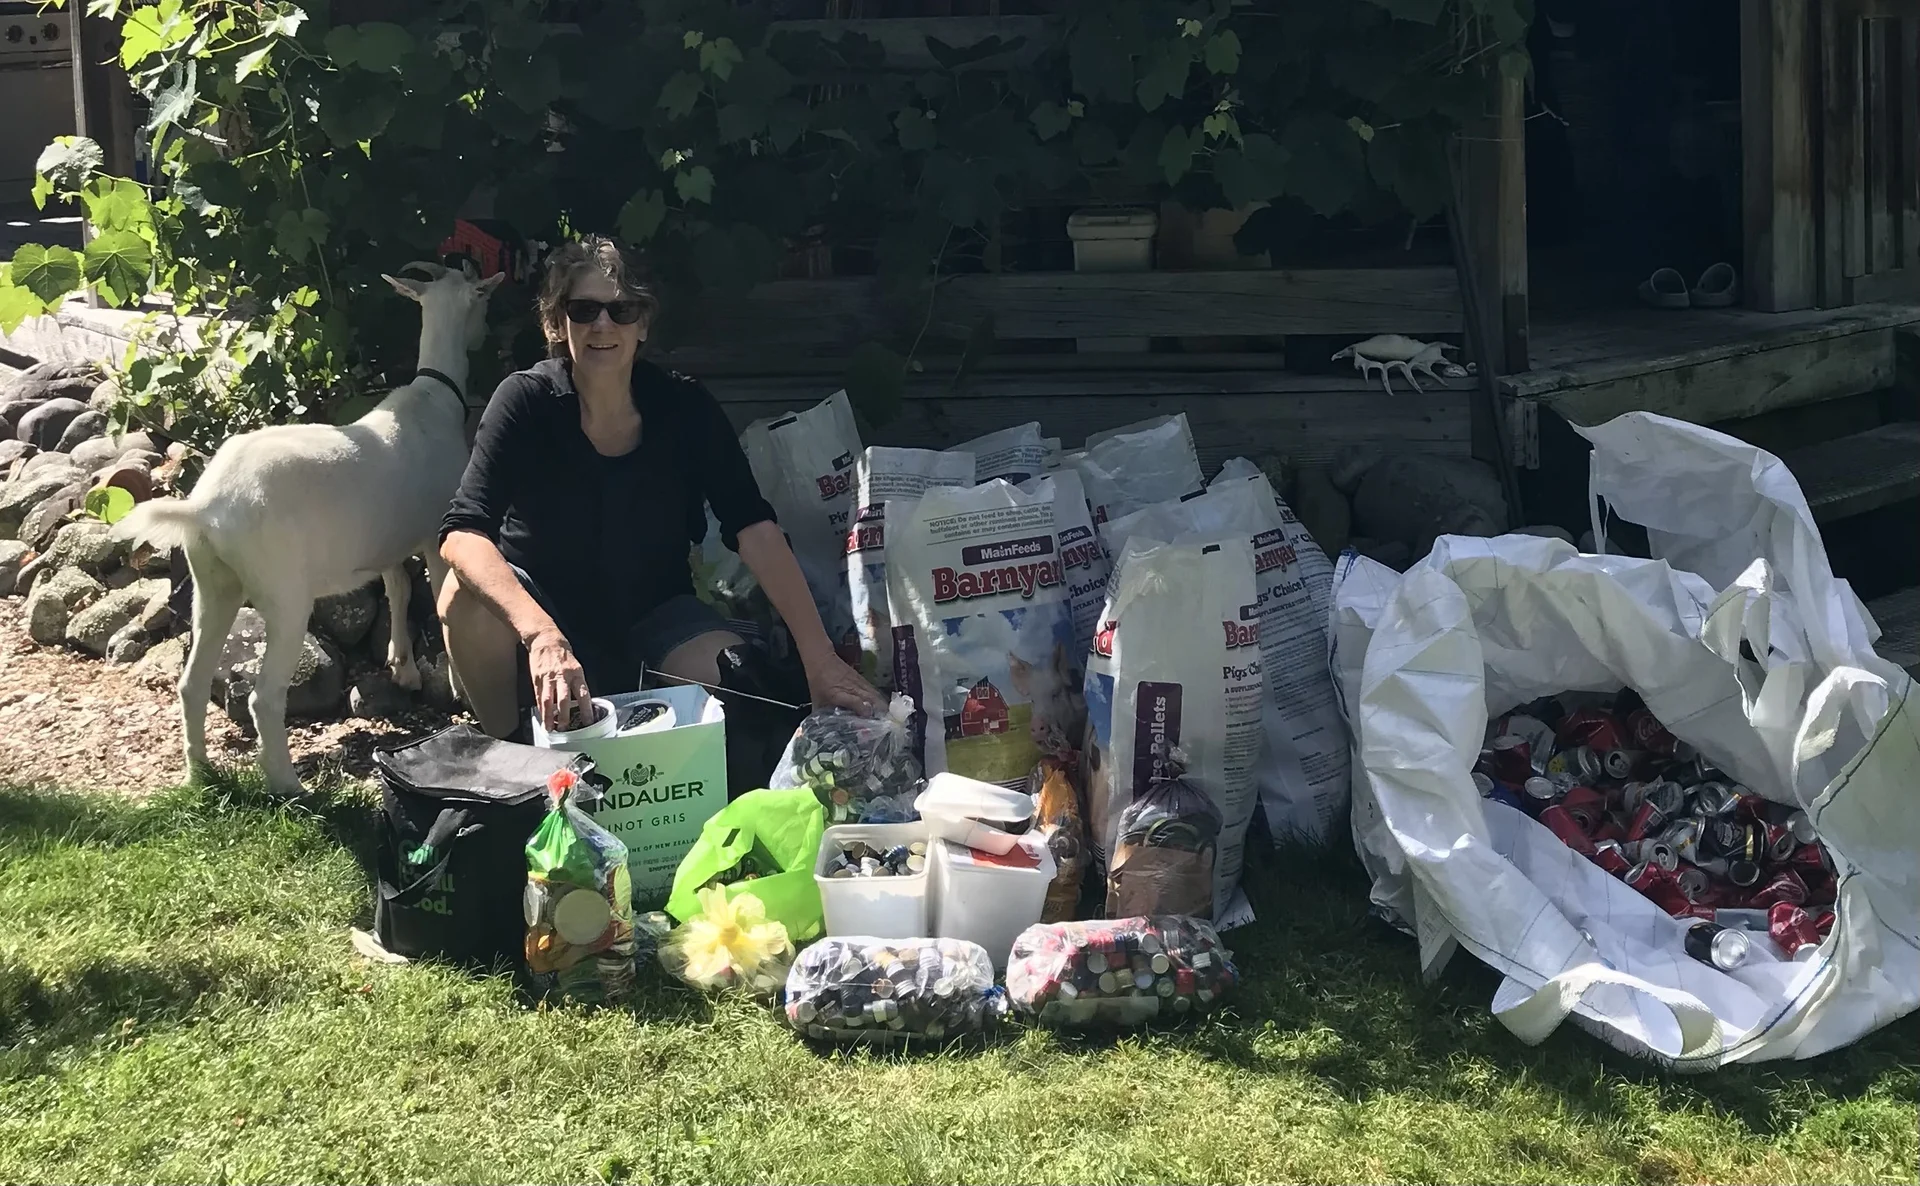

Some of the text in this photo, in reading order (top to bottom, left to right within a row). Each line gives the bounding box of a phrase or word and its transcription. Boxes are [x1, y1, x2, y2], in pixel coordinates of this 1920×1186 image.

[981, 511, 996, 520] feed
[980, 541, 1042, 560] MainFeeds
[651, 812, 686, 827] GRIS
[654, 842, 671, 850] NEW
